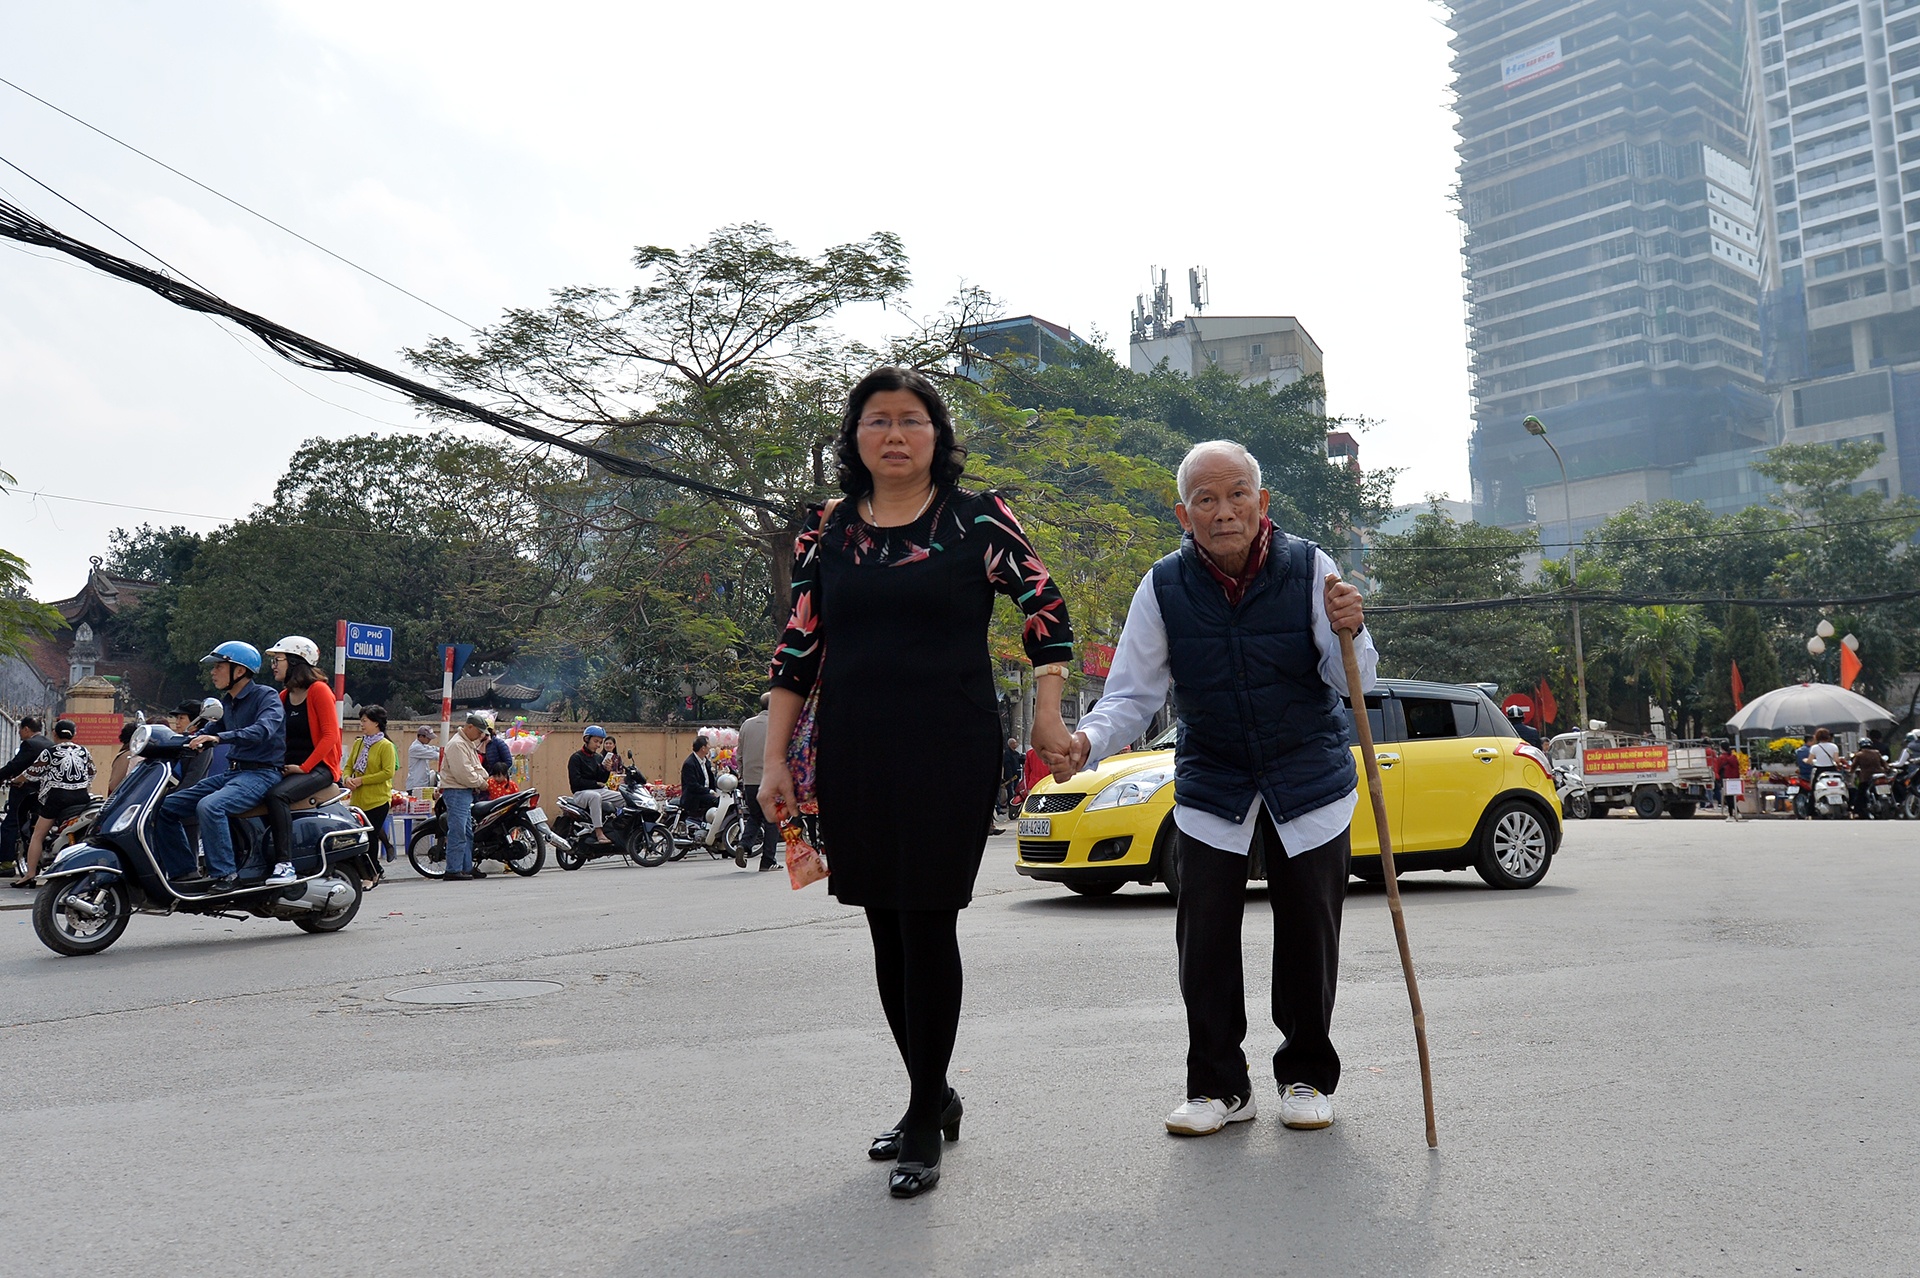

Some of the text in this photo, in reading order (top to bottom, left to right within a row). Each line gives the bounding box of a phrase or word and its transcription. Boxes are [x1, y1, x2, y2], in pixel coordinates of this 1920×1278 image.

[367, 630, 383, 639] PHỐ
[354, 641, 385, 657] CHÙA HÀ
